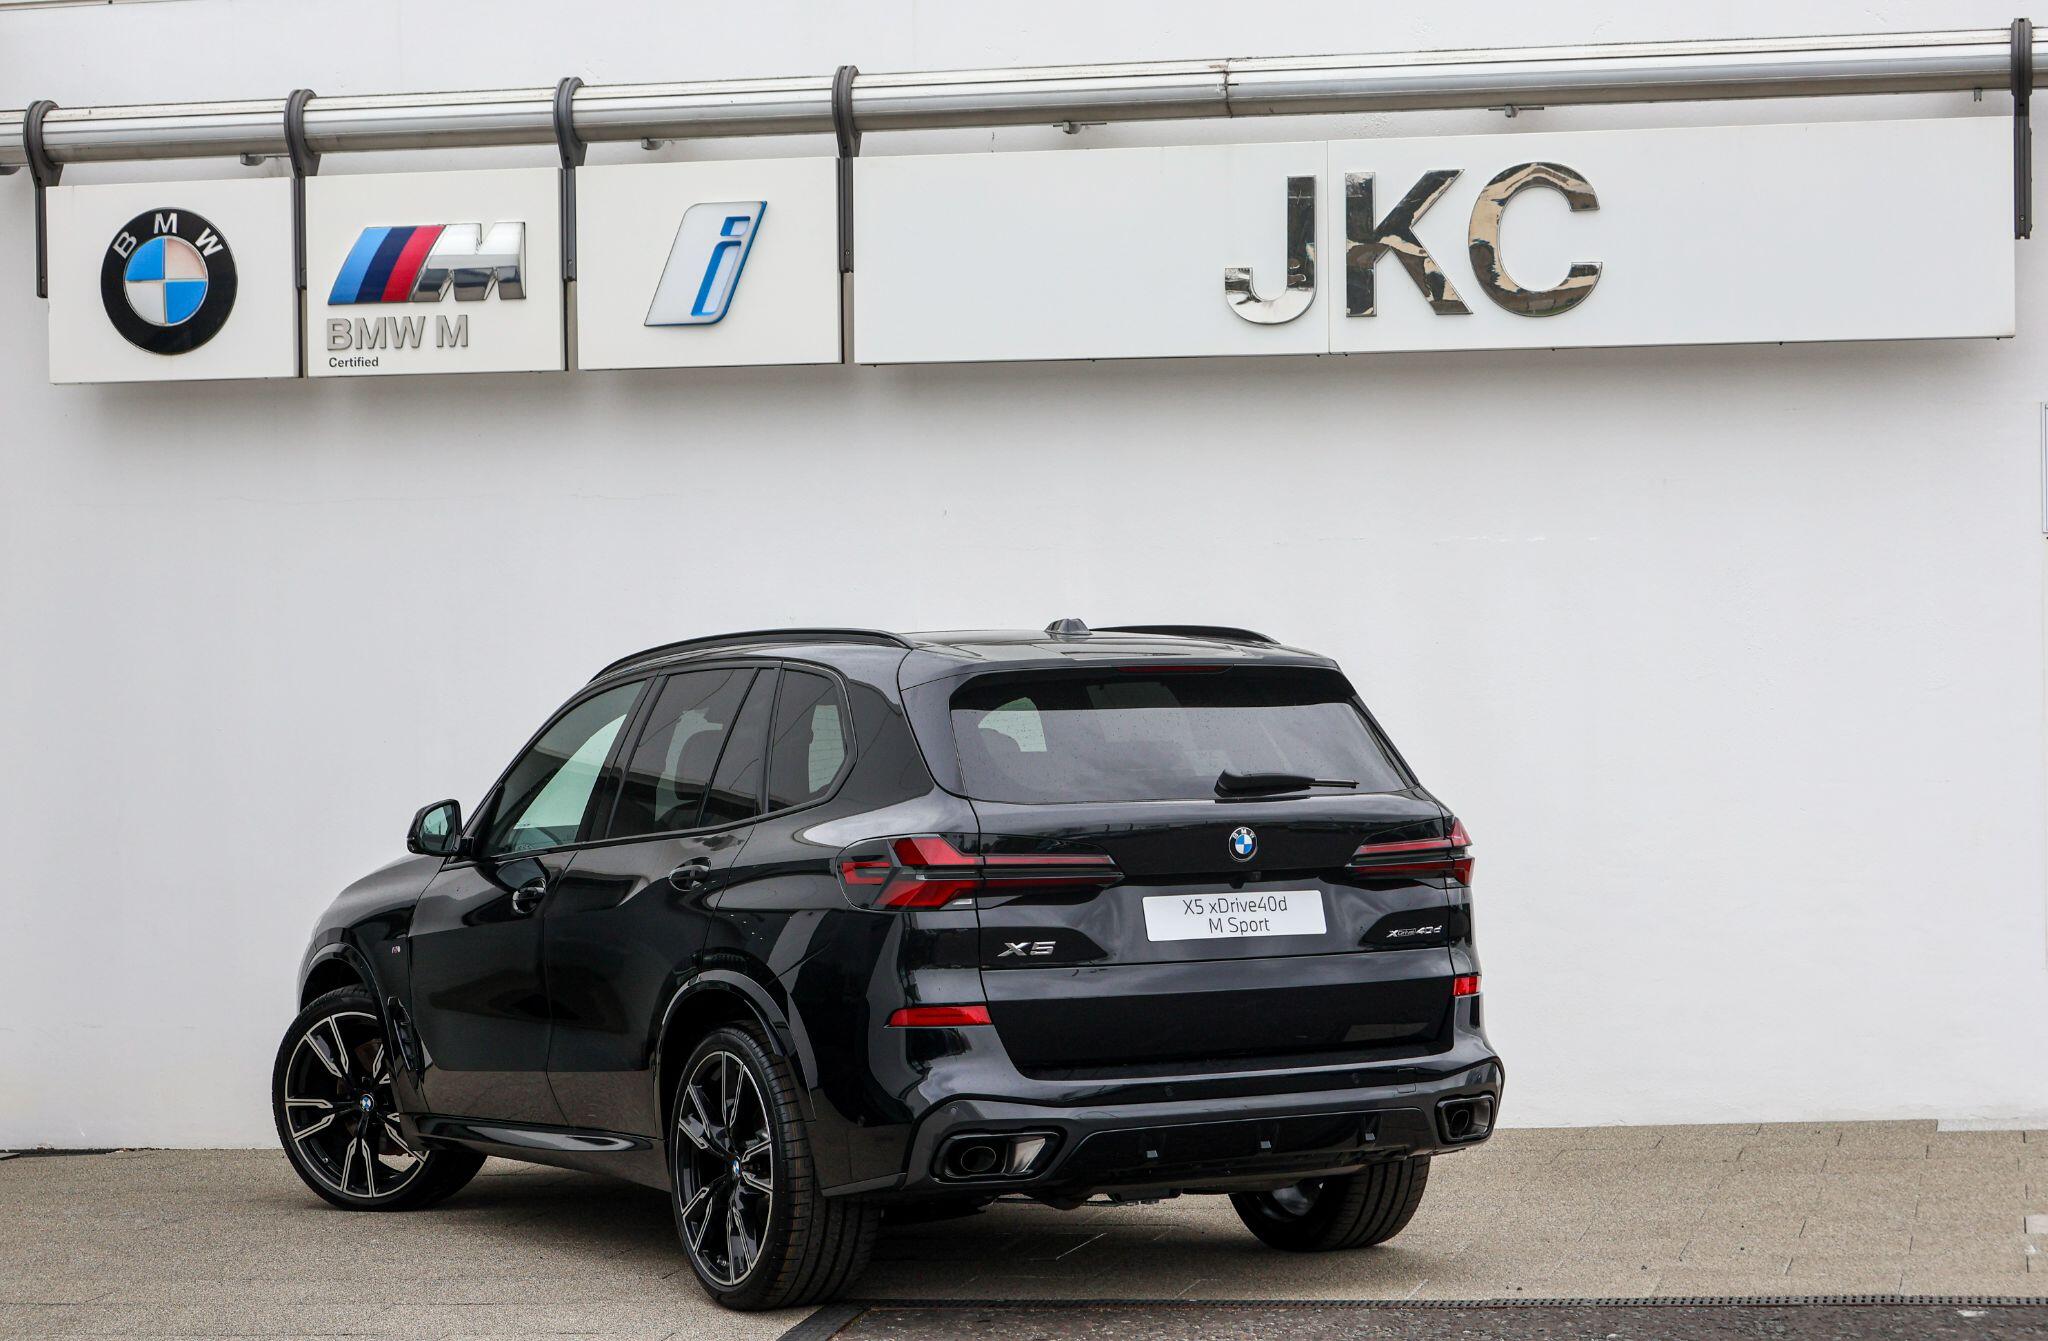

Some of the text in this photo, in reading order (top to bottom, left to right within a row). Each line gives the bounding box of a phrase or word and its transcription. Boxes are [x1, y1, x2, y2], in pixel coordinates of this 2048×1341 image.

[112, 212, 224, 259] BMW
[1224, 161, 1604, 325] JKC
[327, 314, 469, 351] BMW M
[328, 356, 379, 368] Certified
[1182, 896, 1288, 915] X5 xDrive40d
[1208, 916, 1270, 935] M Sport
[997, 941, 1056, 957] X5
